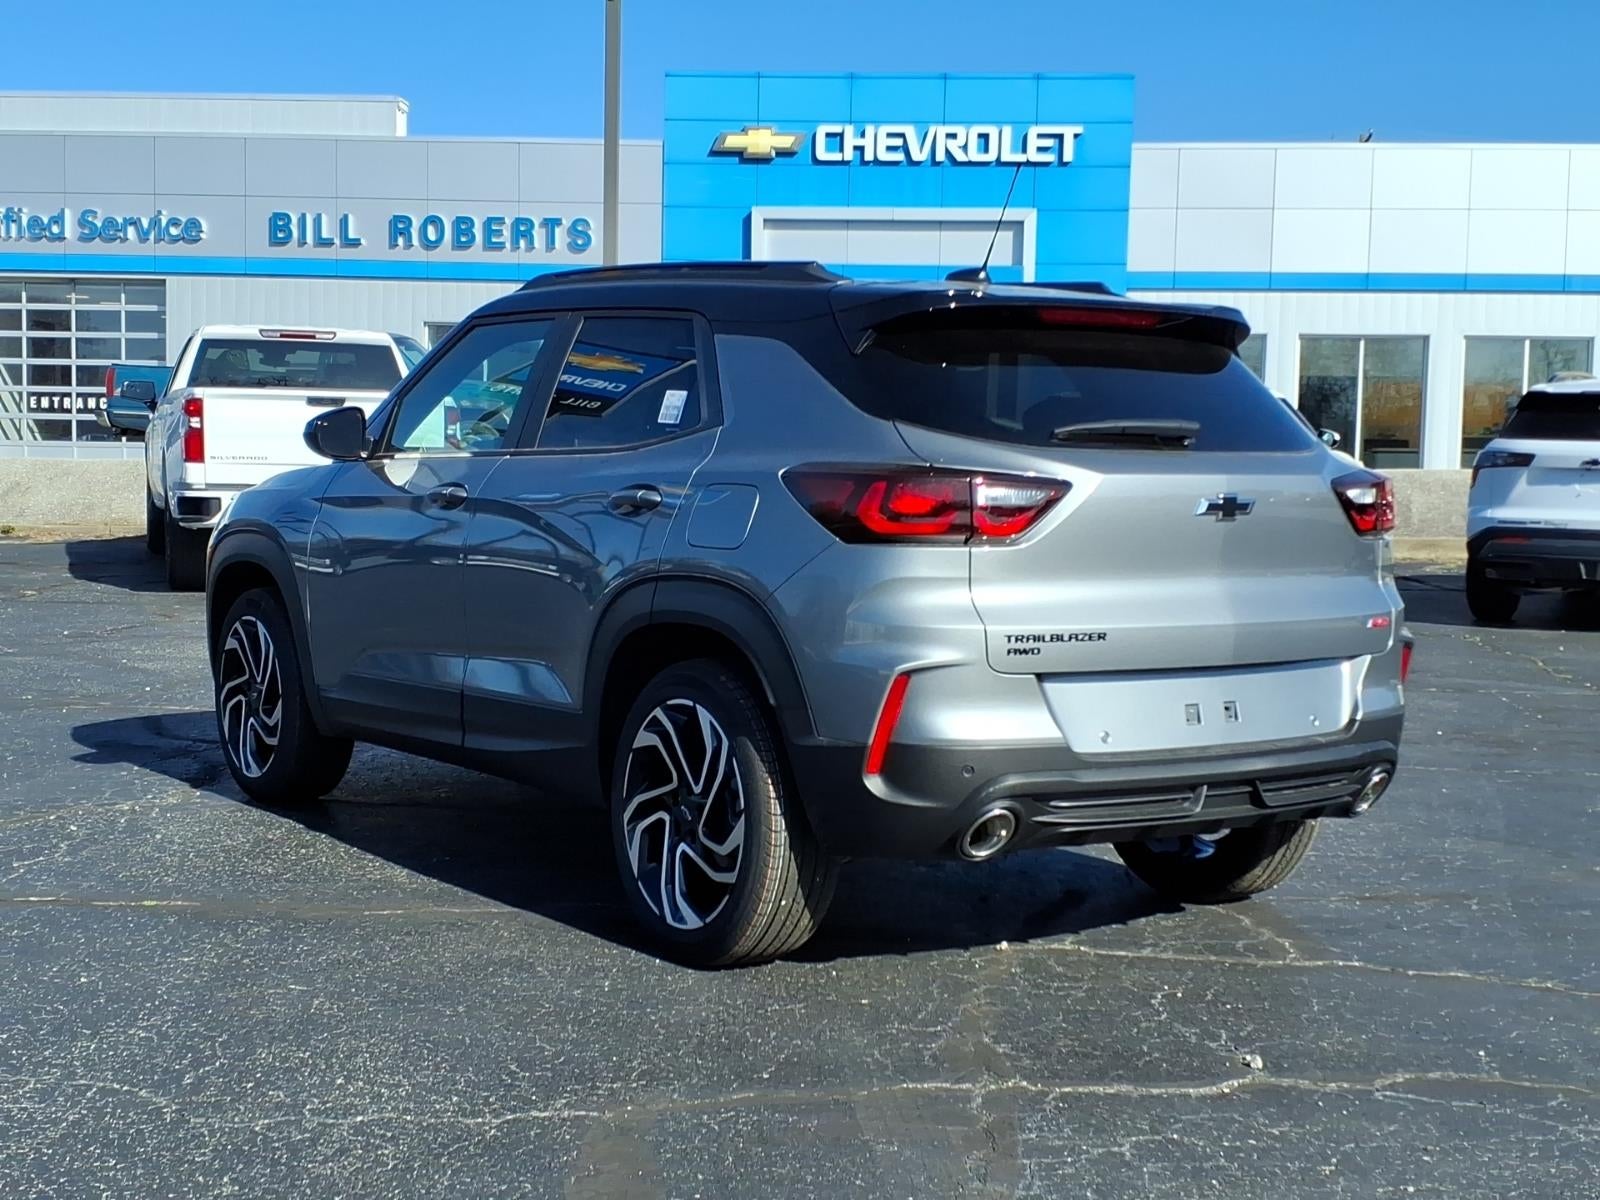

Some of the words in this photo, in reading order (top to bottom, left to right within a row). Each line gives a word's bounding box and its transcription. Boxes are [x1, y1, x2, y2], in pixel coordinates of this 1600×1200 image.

[812, 124, 1084, 164] CHEVROLET
[0, 207, 67, 242] fied
[78, 208, 204, 243] Service
[269, 211, 362, 247] BILL
[389, 213, 593, 252] ROBERTS
[1004, 632, 1107, 644] TRAILBLAZER
[1006, 647, 1041, 656] AWD
